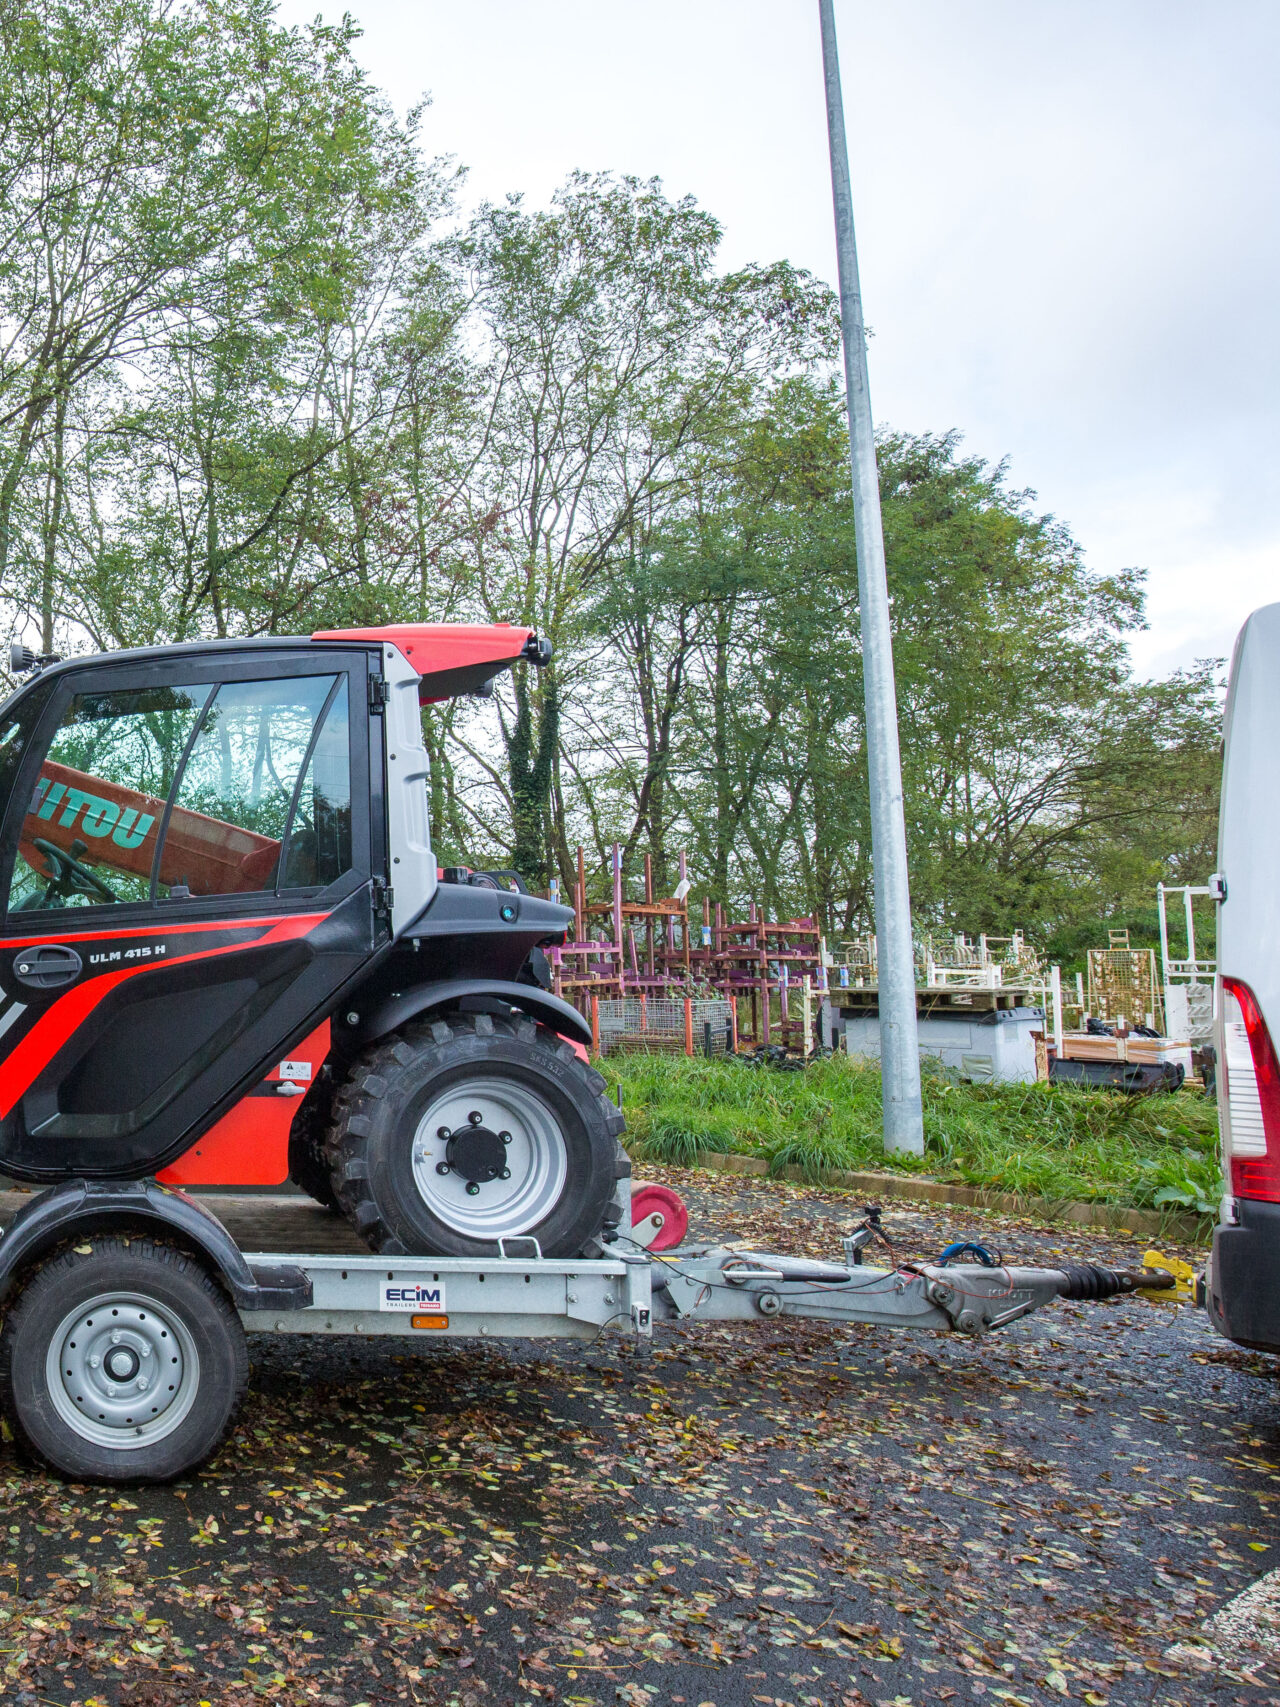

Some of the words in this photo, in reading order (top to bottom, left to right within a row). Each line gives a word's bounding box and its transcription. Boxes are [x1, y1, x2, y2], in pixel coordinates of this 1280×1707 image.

[89, 951, 121, 964] ULM
[124, 947, 152, 959] 415
[154, 945, 166, 955] H
